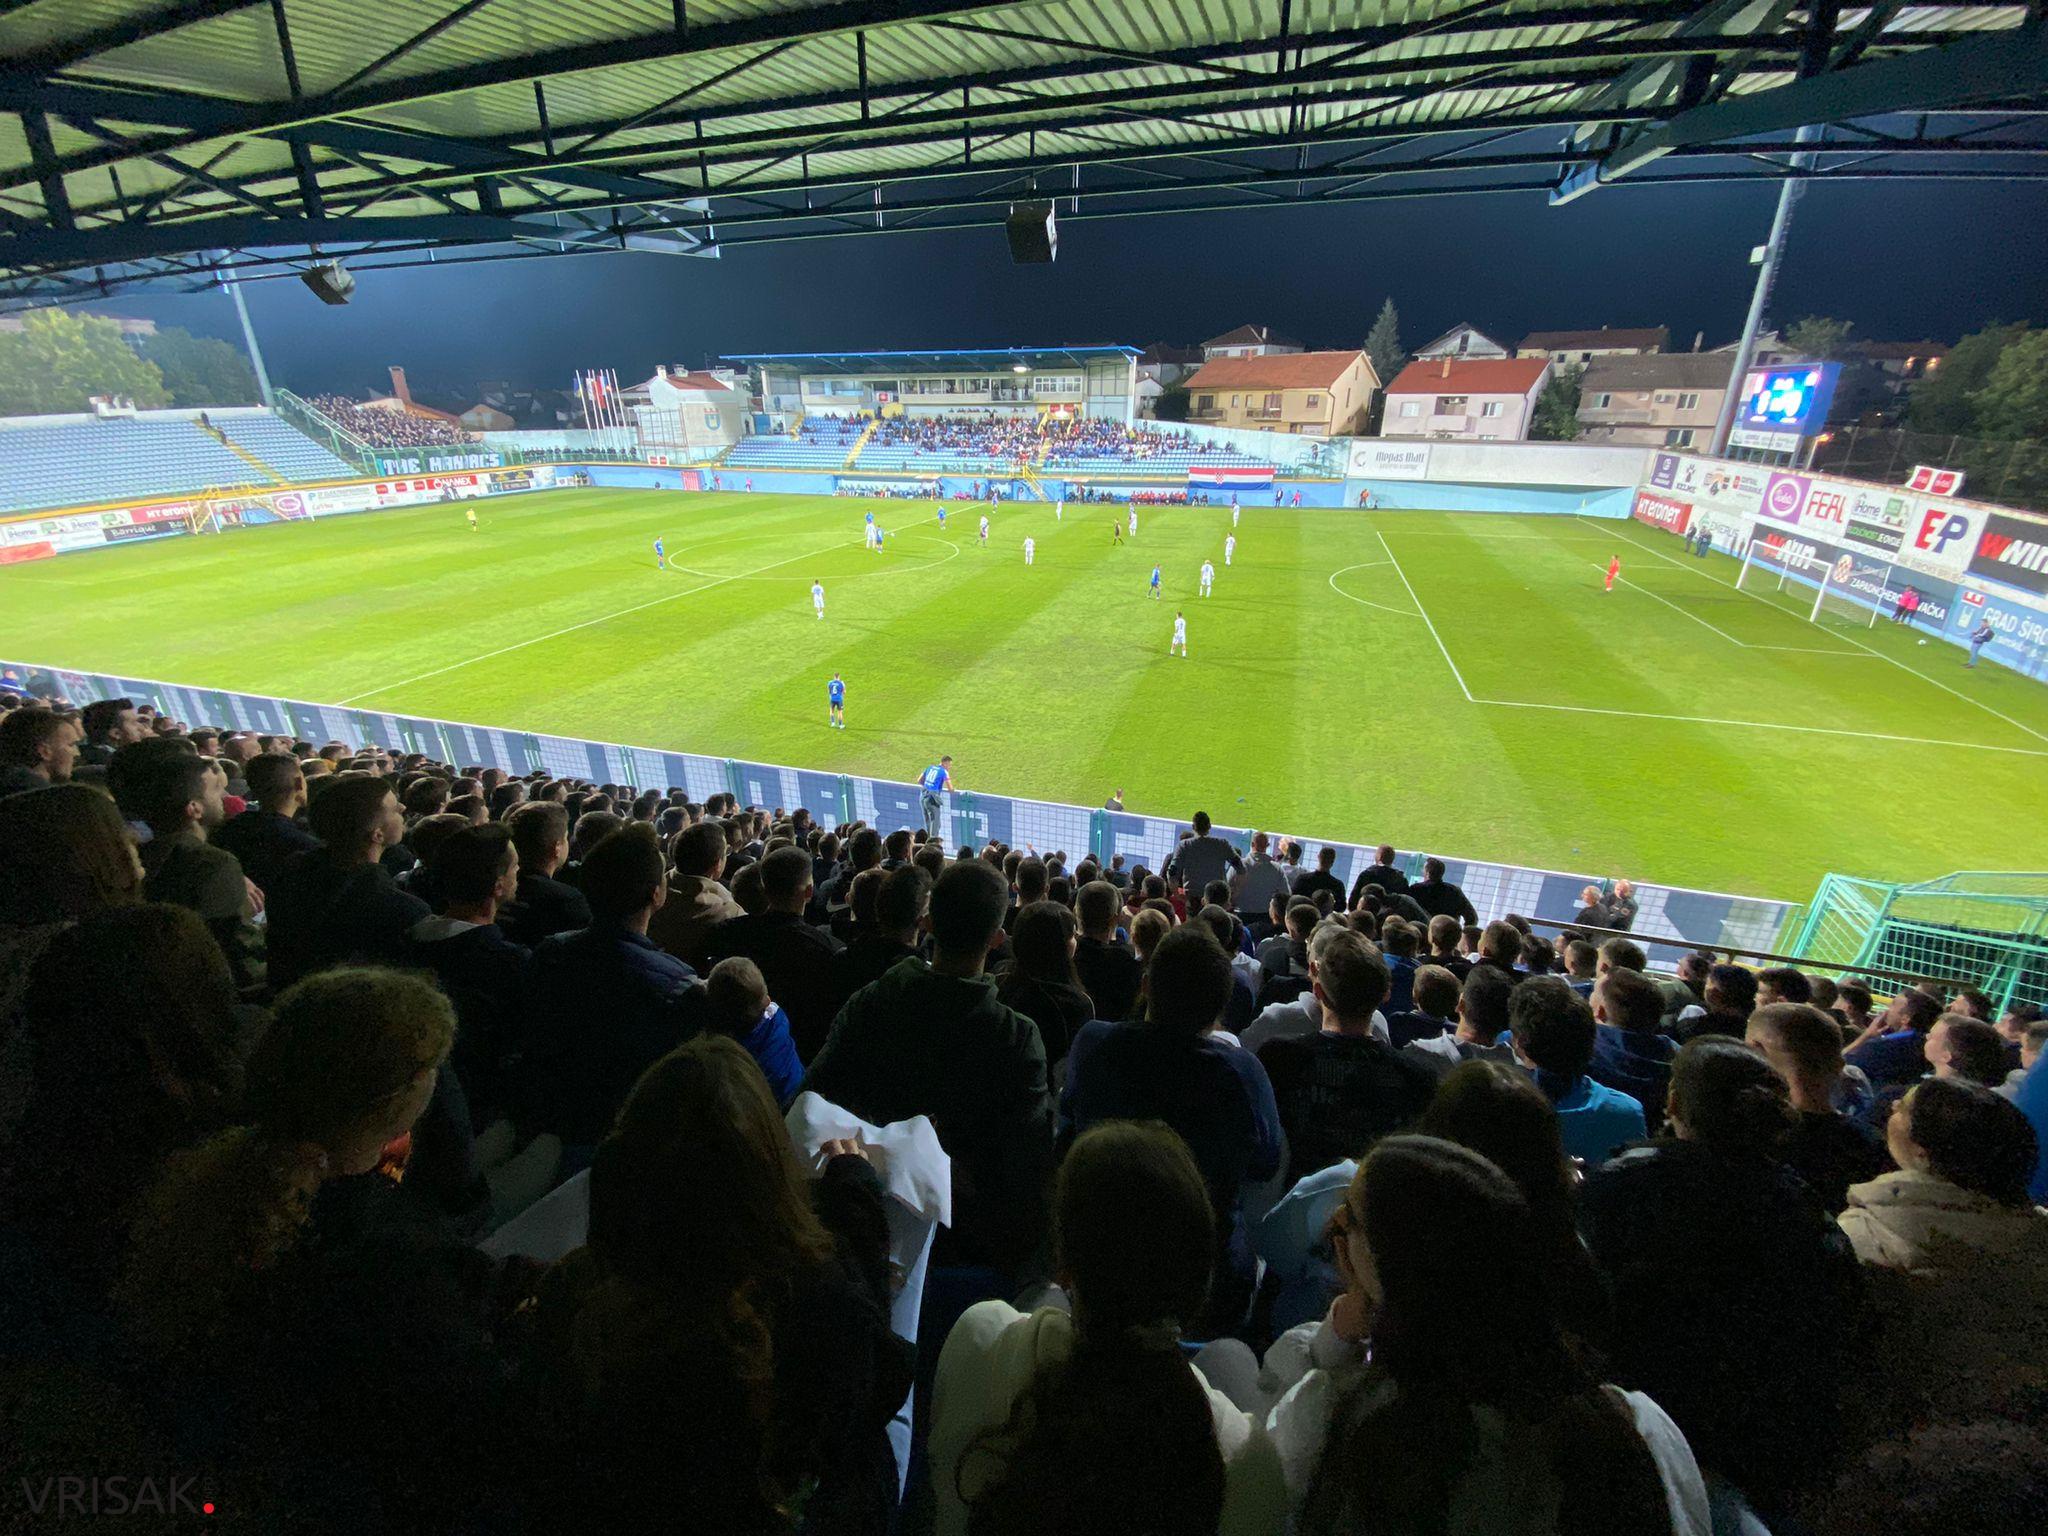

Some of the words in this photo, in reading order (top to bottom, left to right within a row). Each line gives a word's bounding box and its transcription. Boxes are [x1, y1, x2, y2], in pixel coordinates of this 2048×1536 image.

[383, 458, 420, 475] THE
[1806, 490, 1847, 523] FEAL
[1914, 508, 1970, 554] EP
[1849, 577, 1946, 620] ZAPADNOHERCVAČKA
[1983, 607, 2018, 633] GRAD
[926, 768, 938, 783] 10
